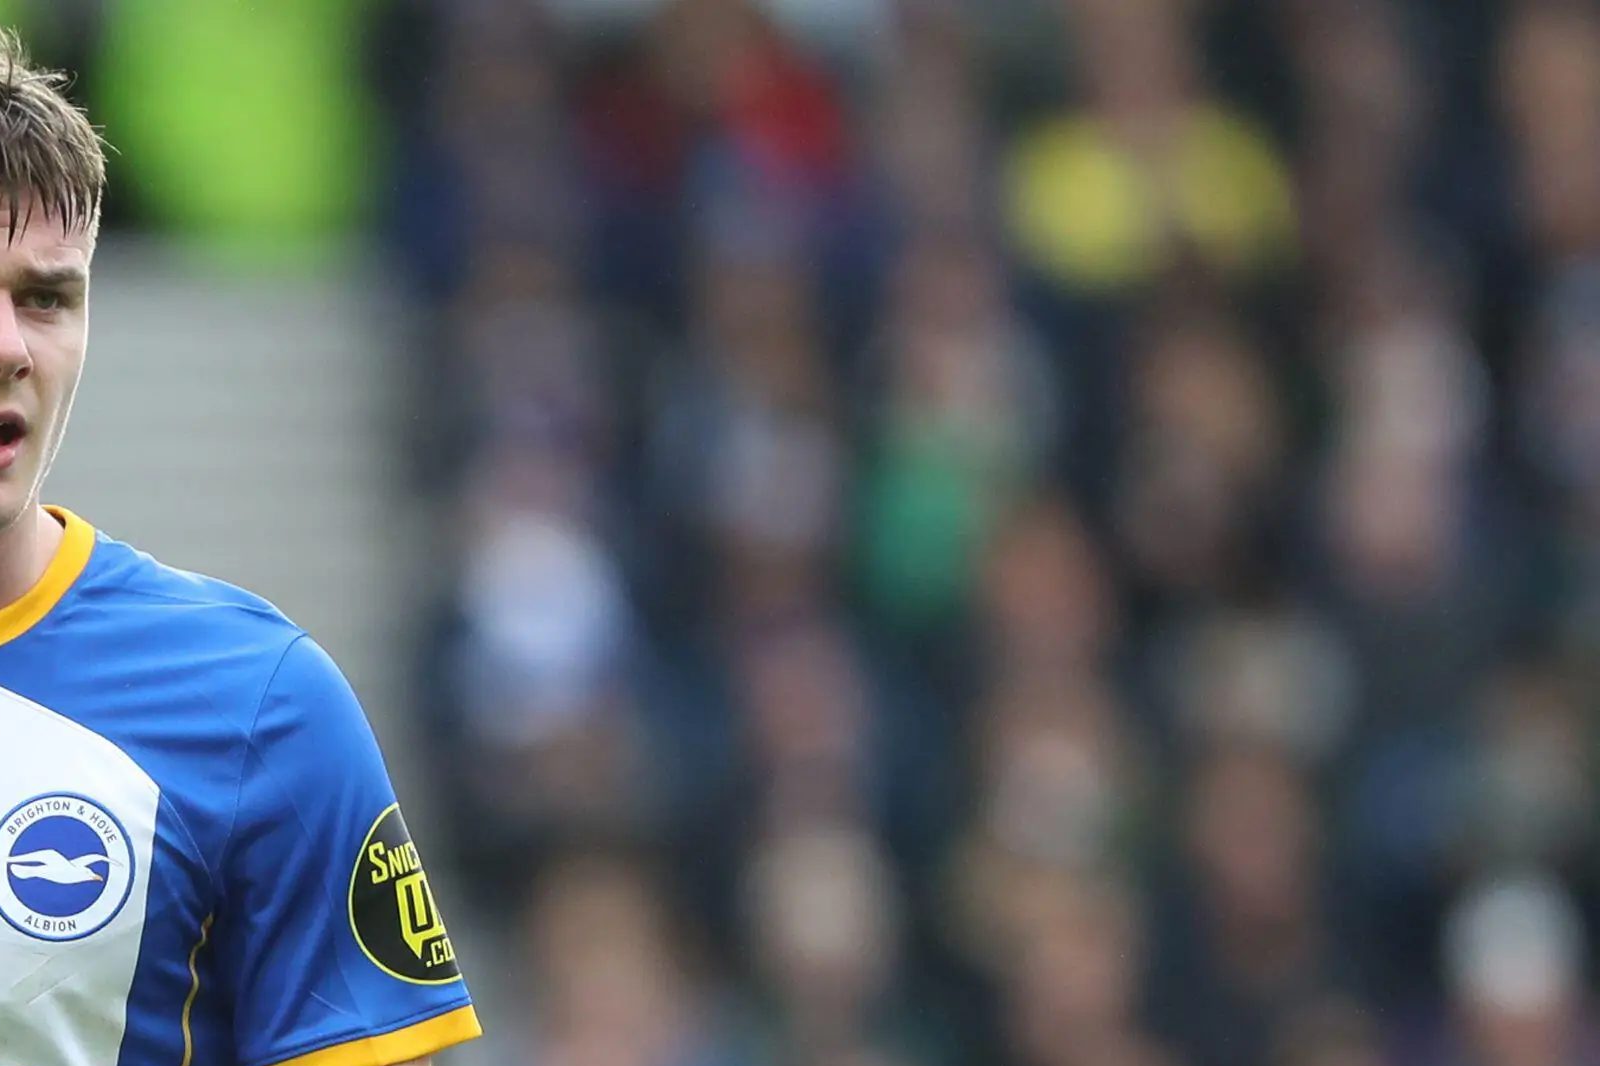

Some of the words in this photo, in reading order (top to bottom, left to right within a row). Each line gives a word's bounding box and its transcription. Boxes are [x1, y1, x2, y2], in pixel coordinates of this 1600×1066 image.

[7, 800, 71, 835] BRIGHTON
[77, 805, 86, 815] &
[90, 813, 117, 844] HOVE
[24, 915, 77, 932] ALBION
